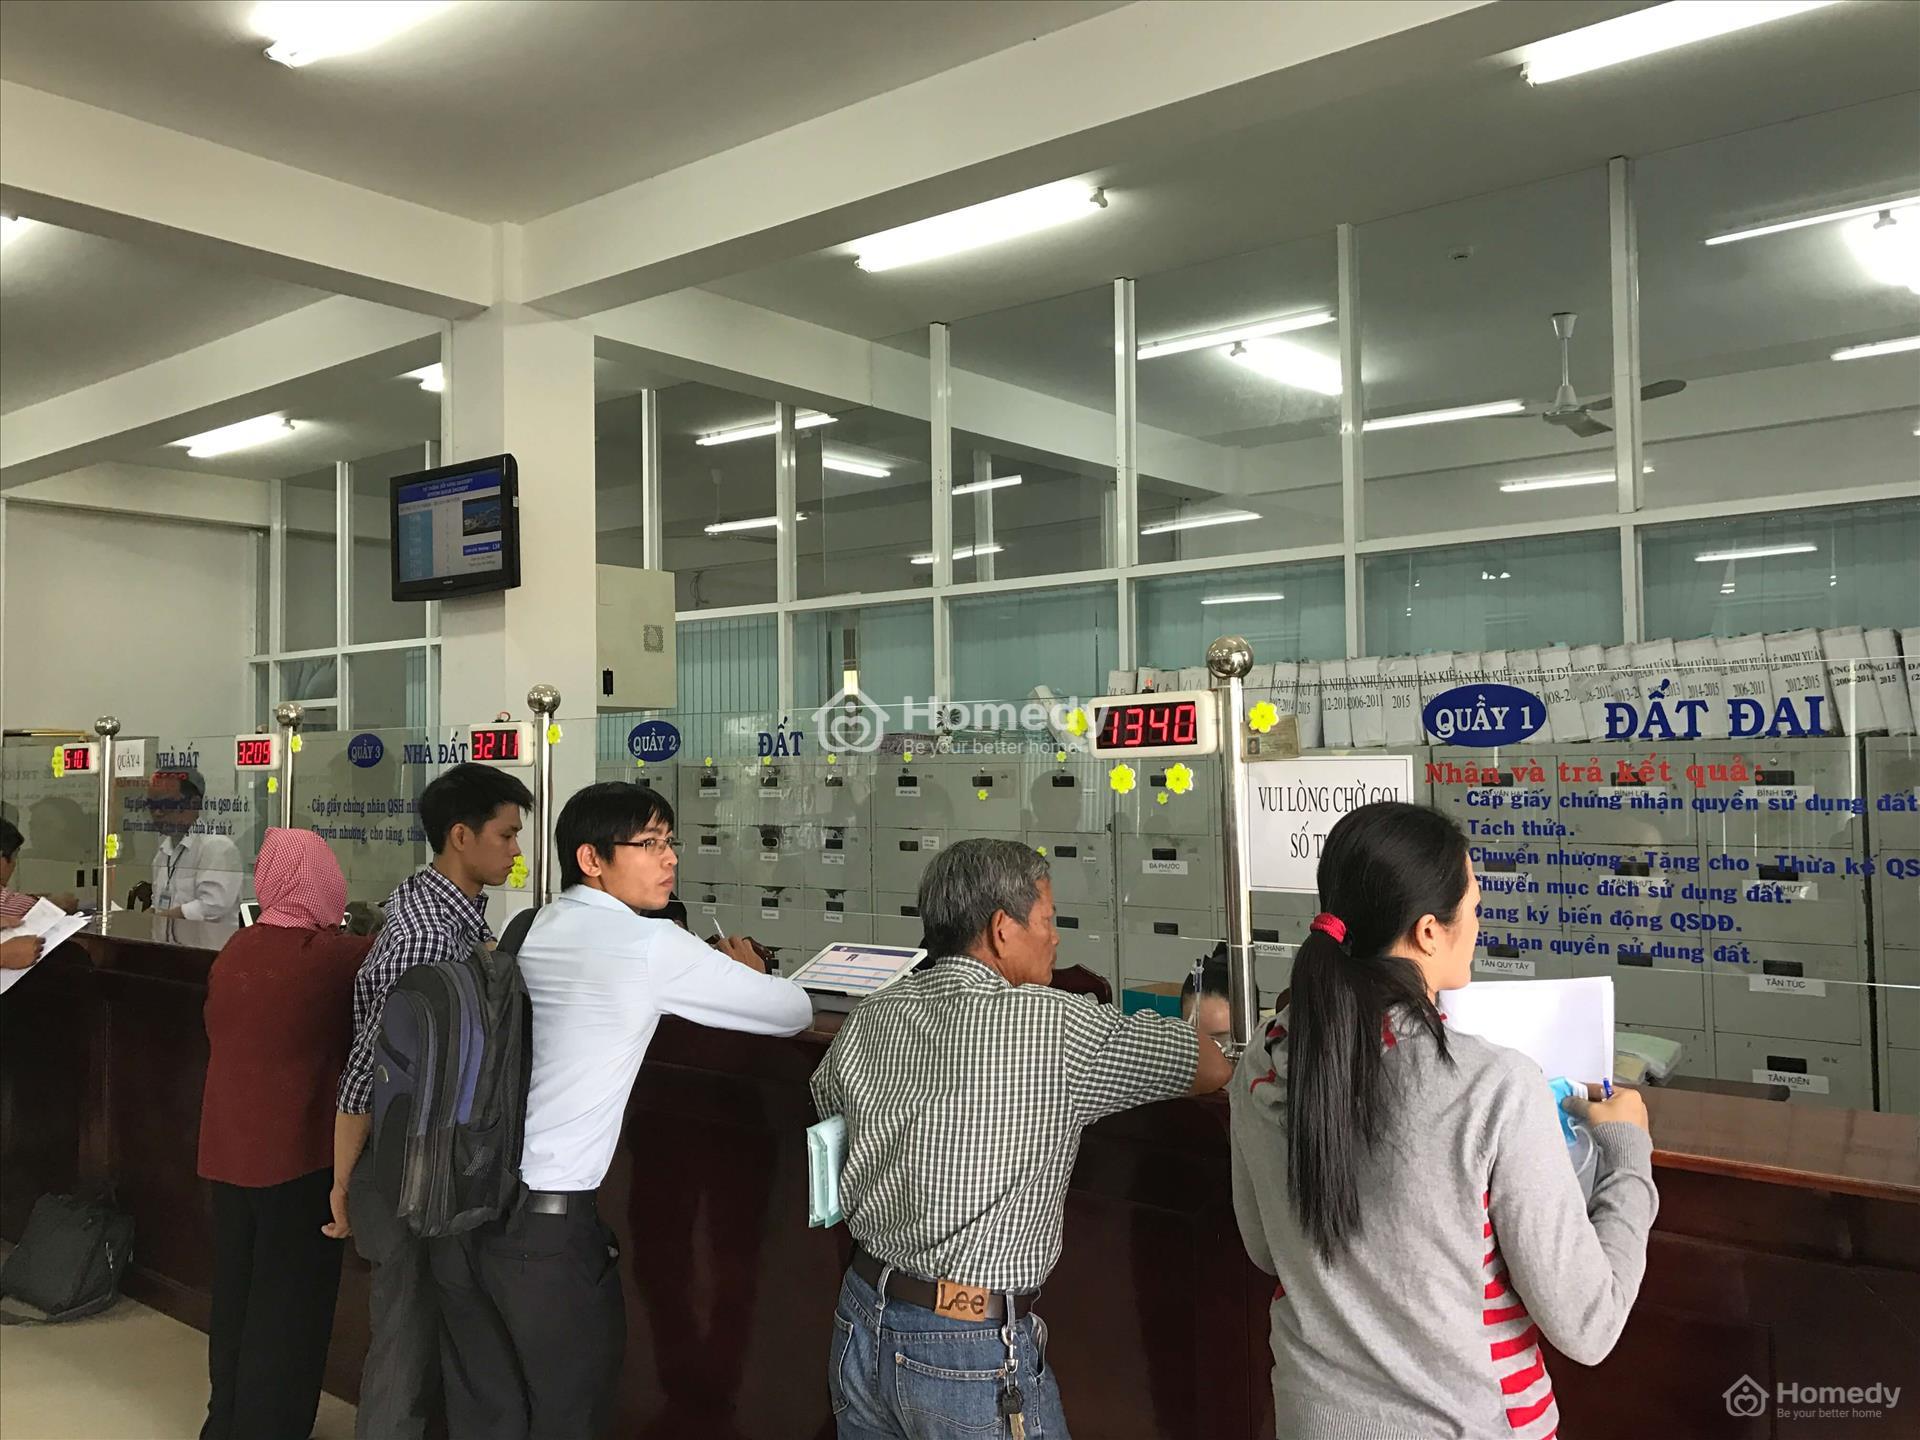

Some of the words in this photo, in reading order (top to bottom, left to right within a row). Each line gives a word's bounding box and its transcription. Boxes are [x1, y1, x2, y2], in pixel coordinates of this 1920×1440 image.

[1786, 674, 1820, 694] 2012-2015
[1880, 674, 1896, 685] 2015
[1392, 694, 1411, 709] 2015
[1604, 678, 1710, 738] ĐẤT
[1727, 696, 1825, 737] ĐAI
[1110, 705, 1196, 746] 1340
[1435, 694, 1510, 739] QUẦY
[1521, 706, 1534, 730] 1
[403, 736, 434, 764] NHÀ
[438, 731, 469, 764] ĐẤT
[633, 727, 664, 756] QUẦY
[668, 734, 678, 751] 2
[757, 716, 804, 757] ĐẤT
[156, 746, 178, 769] NHÀ
[179, 741, 200, 769] ĐẤT
[238, 741, 271, 765] 3209
[375, 745, 381, 760] 3
[1425, 758, 1501, 789] Nhận
[1510, 758, 1546, 784] và
[1558, 757, 1603, 784] trả
[1616, 752, 1673, 784] kết
[312, 795, 325, 817] Cấp
[327, 793, 341, 817] giấy
[1258, 786, 1283, 813] VUI
[1287, 779, 1330, 813] LÒNG
[1333, 779, 1367, 813] CHỜ
[1466, 788, 1503, 809] Cấp
[1511, 788, 1552, 810] giấy
[1560, 790, 1622, 811] chứng
[1631, 792, 1683, 814] nhận
[1692, 789, 1759, 812] quyền
[1768, 789, 1798, 811] sử
[1805, 793, 1866, 816] dụng
[1876, 789, 1919, 812] đất
[370, 826, 384, 841] cho
[1290, 821, 1311, 859] SỐ
[1468, 818, 1515, 836] Tách
[1522, 818, 1575, 837] thửa.
[1470, 843, 1540, 867] Chuyển
[1546, 848, 1622, 871] nhượng
[1644, 851, 1700, 874] Tặng
[1708, 854, 1750, 872] cho
[1774, 854, 1837, 876] Thừa
[1846, 854, 1876, 876] kế
[1546, 880, 1589, 900] mục
[1596, 879, 1640, 899] đích
[1647, 878, 1675, 900] sử
[1681, 882, 1738, 905] dụng
[1527, 904, 1549, 925] ký
[1558, 904, 1603, 927] biến
[1609, 909, 1664, 932] động
[1506, 932, 1543, 955] hạn
[1550, 934, 1610, 957] quyền
[1617, 936, 1645, 956] sử
[1766, 977, 1785, 986] TÂN
[1768, 1073, 1787, 1083] TÂN
[938, 1283, 985, 1315] Lee
